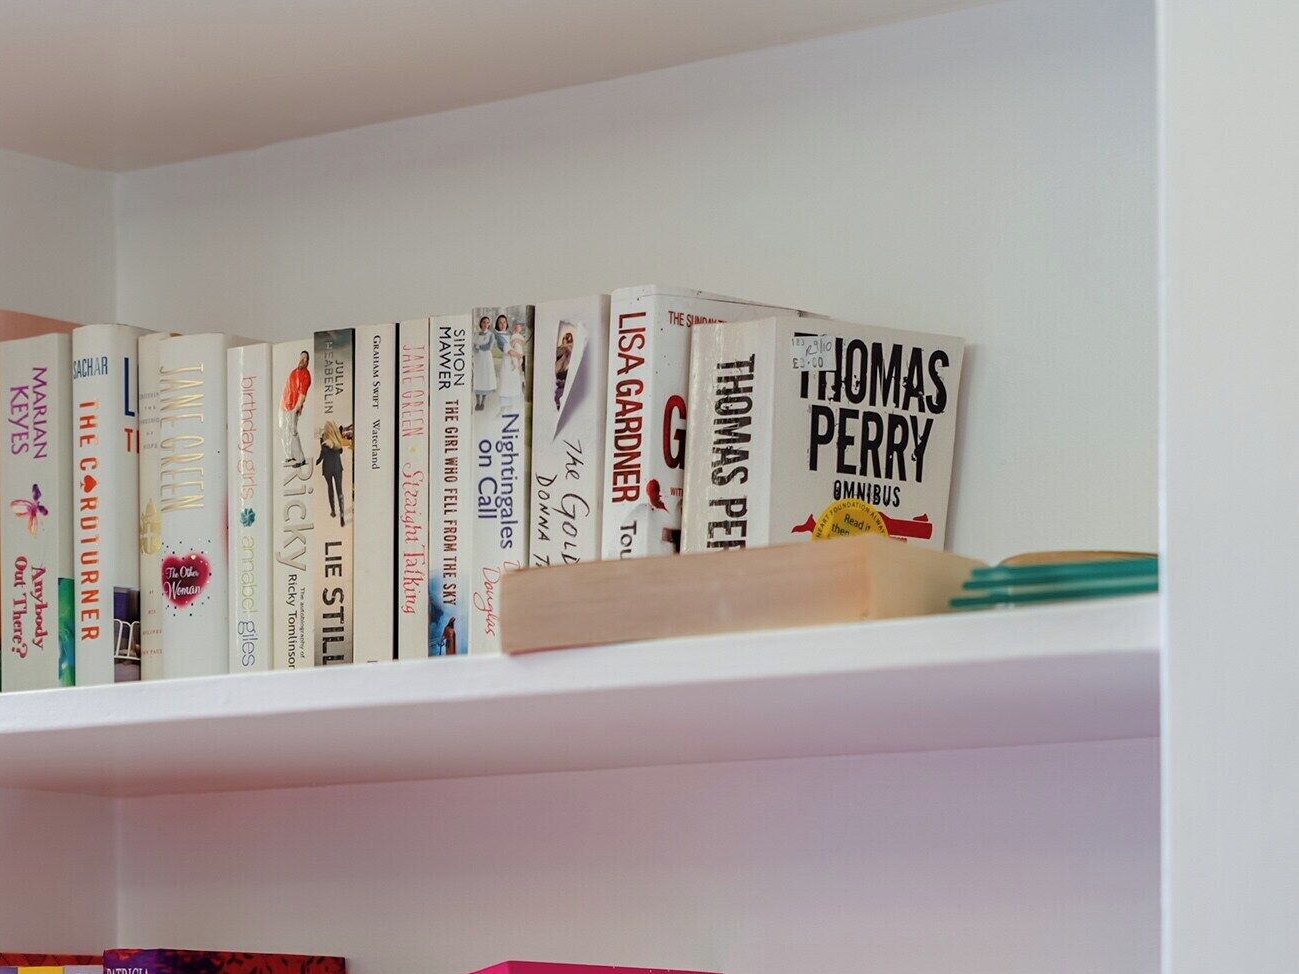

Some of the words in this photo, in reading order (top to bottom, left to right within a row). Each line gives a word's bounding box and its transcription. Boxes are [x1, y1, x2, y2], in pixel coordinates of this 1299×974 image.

[669, 311, 684, 326] THE
[438, 327, 451, 390] MAWER
[453, 329, 466, 386] SIMON
[616, 312, 646, 375] LISA
[324, 340, 334, 414] HEABERLIN
[335, 360, 344, 395] JULIA
[794, 332, 950, 414] THOMAS
[9, 386, 29, 455] KEYES
[32, 367, 48, 459] MARIAN
[79, 400, 98, 447] THE
[238, 376, 257, 454] birthday
[444, 400, 458, 421] THE
[711, 354, 755, 487] THOMAS
[371, 419, 381, 470] Waterland
[444, 427, 458, 453] GIRL
[479, 440, 493, 467] on
[563, 439, 584, 480] The
[612, 380, 644, 503] GARDNER
[809, 404, 934, 483] PERRY
[237, 459, 257, 500] girls
[444, 457, 458, 483] WHO
[495, 413, 520, 549] Nightingales
[443, 488, 458, 515] FELL
[478, 477, 498, 518] Call
[536, 473, 558, 540] DONNA
[830, 502, 869, 515] FOUNDATION
[833, 480, 900, 507] OMNIBUS
[443, 520, 458, 552] FROM
[844, 514, 863, 530] Read
[13, 556, 28, 590] Out
[166, 567, 179, 579] The
[180, 566, 199, 579] Other
[241, 536, 258, 613] annabel
[324, 541, 342, 577] LIE
[443, 557, 457, 578] THE
[31, 566, 48, 650] Anybody
[164, 581, 201, 600] Woman
[286, 574, 297, 606] Ricky
[442, 584, 456, 606] SKY
[473, 567, 501, 637] Douglas
[12, 593, 28, 660] There?
[238, 621, 258, 666] giles
